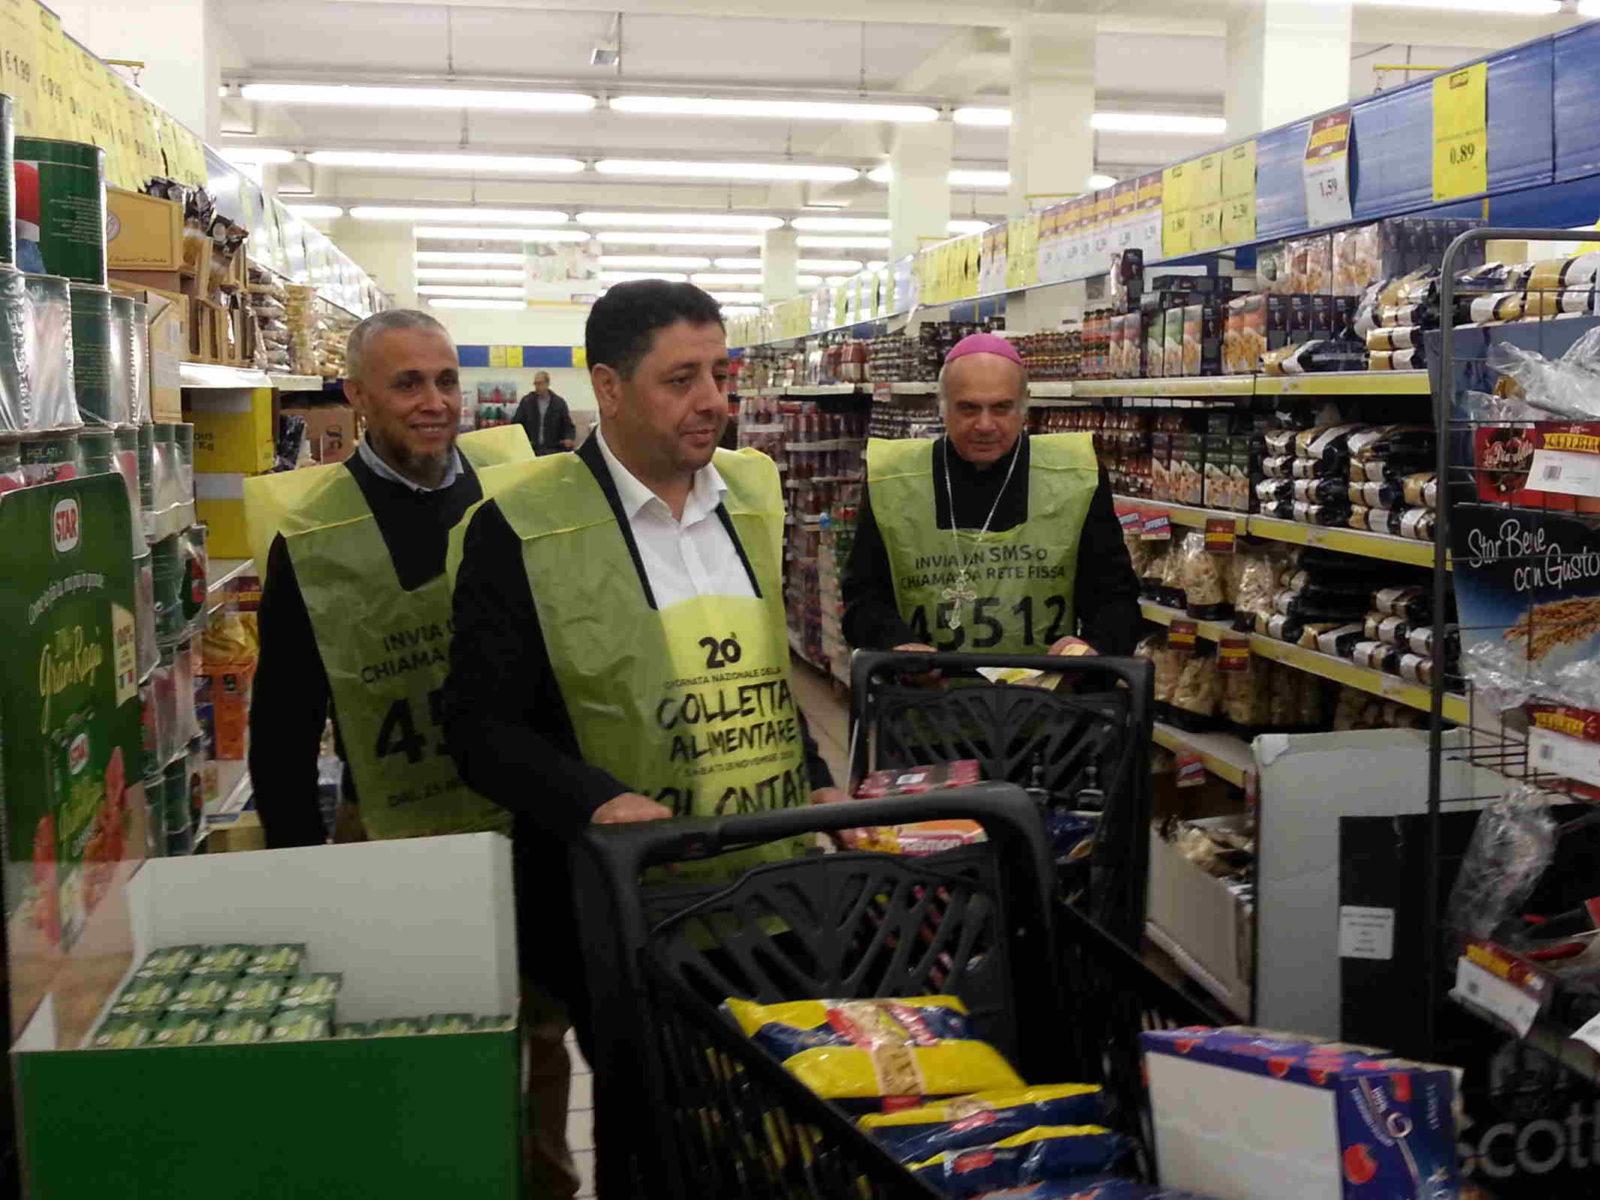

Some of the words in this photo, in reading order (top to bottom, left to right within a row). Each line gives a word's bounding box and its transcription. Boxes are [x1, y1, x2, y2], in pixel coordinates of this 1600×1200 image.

[56, 508, 78, 543] STAR
[916, 554, 958, 570] INVIA
[989, 544, 1030, 563] SMS
[1468, 528, 1502, 568] Star
[1545, 543, 1600, 589] Gusto
[986, 565, 1025, 580] RETE
[1028, 565, 1065, 580] FISSA
[383, 624, 443, 653] INVIA
[362, 647, 445, 683] CHIAMA
[657, 678, 796, 730] COLLETTA
[669, 718, 797, 765] ALIMENTARE
